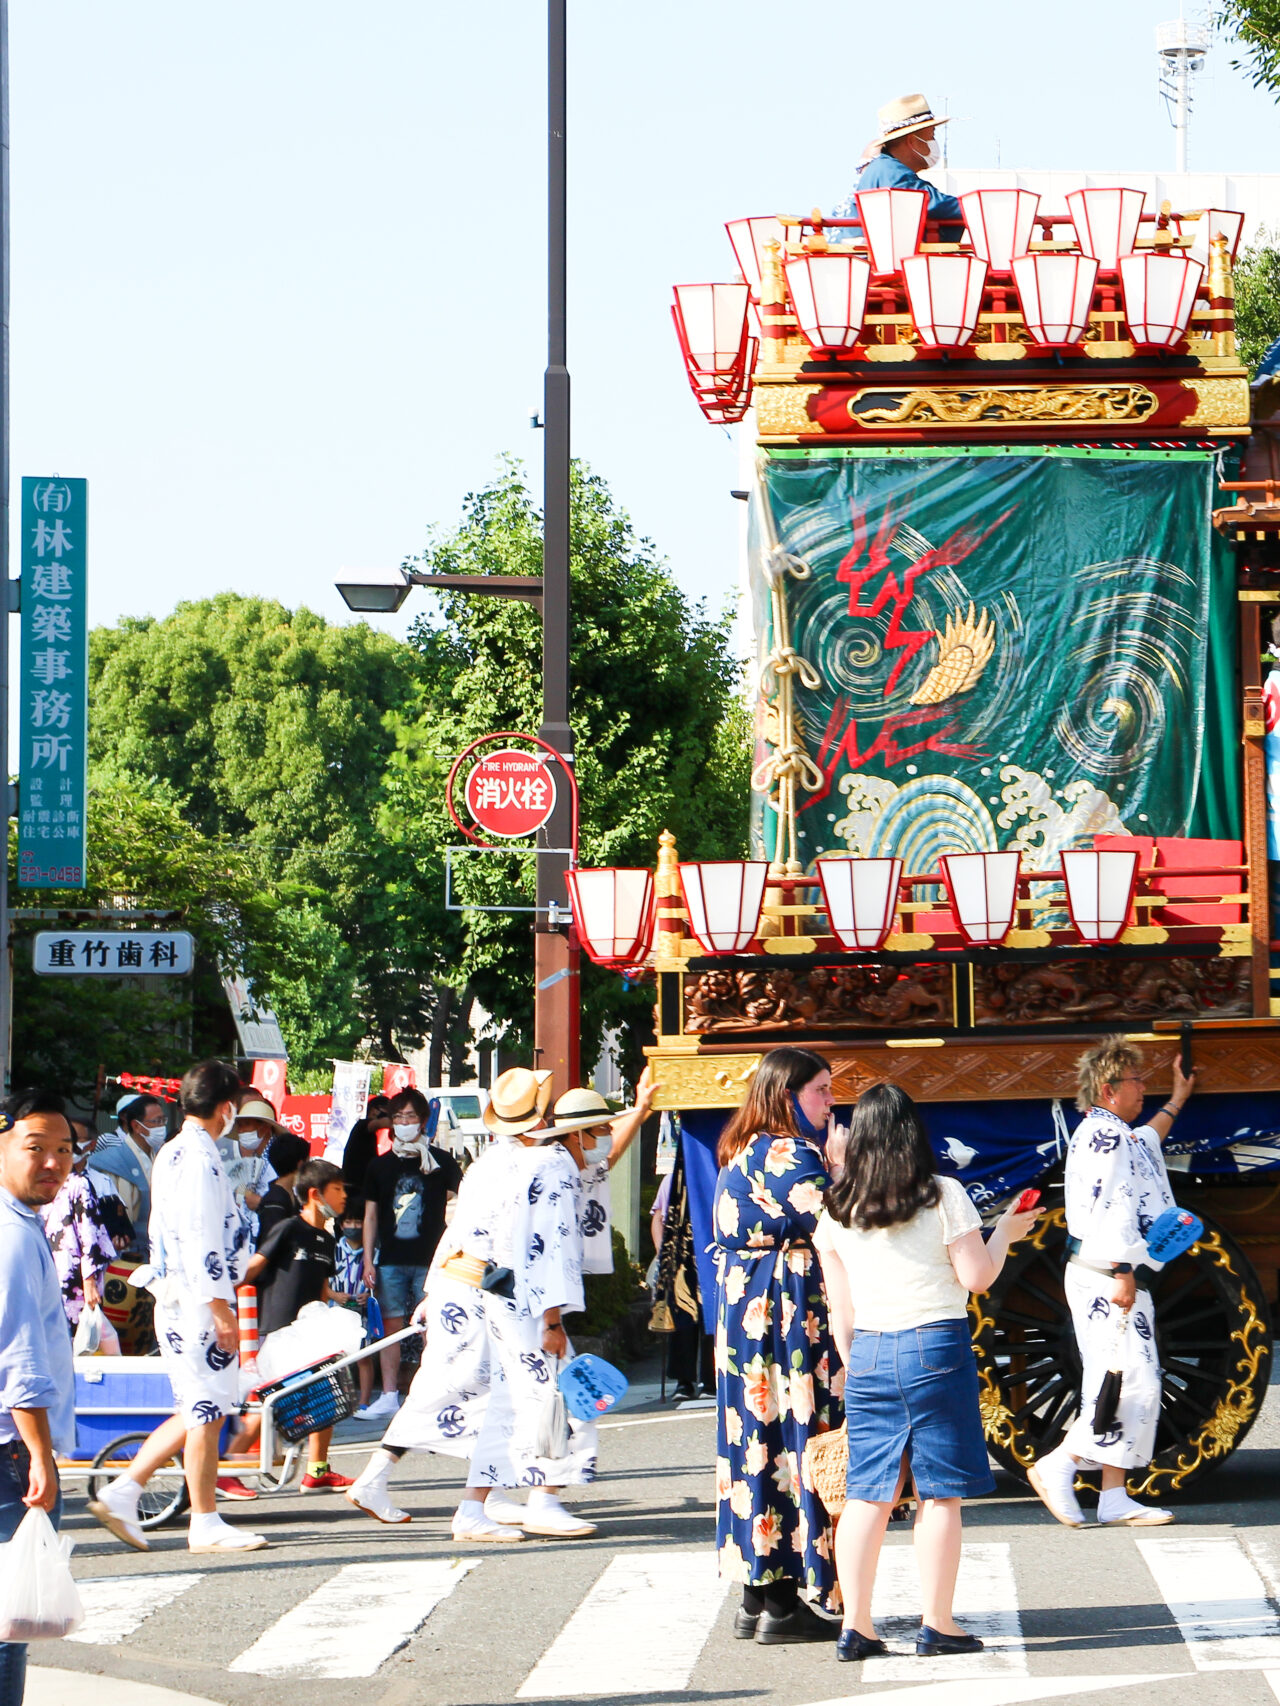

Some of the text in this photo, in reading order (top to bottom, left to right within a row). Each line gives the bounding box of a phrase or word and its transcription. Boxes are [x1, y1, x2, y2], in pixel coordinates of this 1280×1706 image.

[482, 761, 540, 772] FIRE HYDRANT
[475, 777, 548, 810] 消火栓
[22, 809, 80, 823] 耐震診断
[22, 825, 80, 839] 住宅公庫
[20, 866, 81, 882] 521-0458
[48, 938, 179, 968] 重竹歯科
